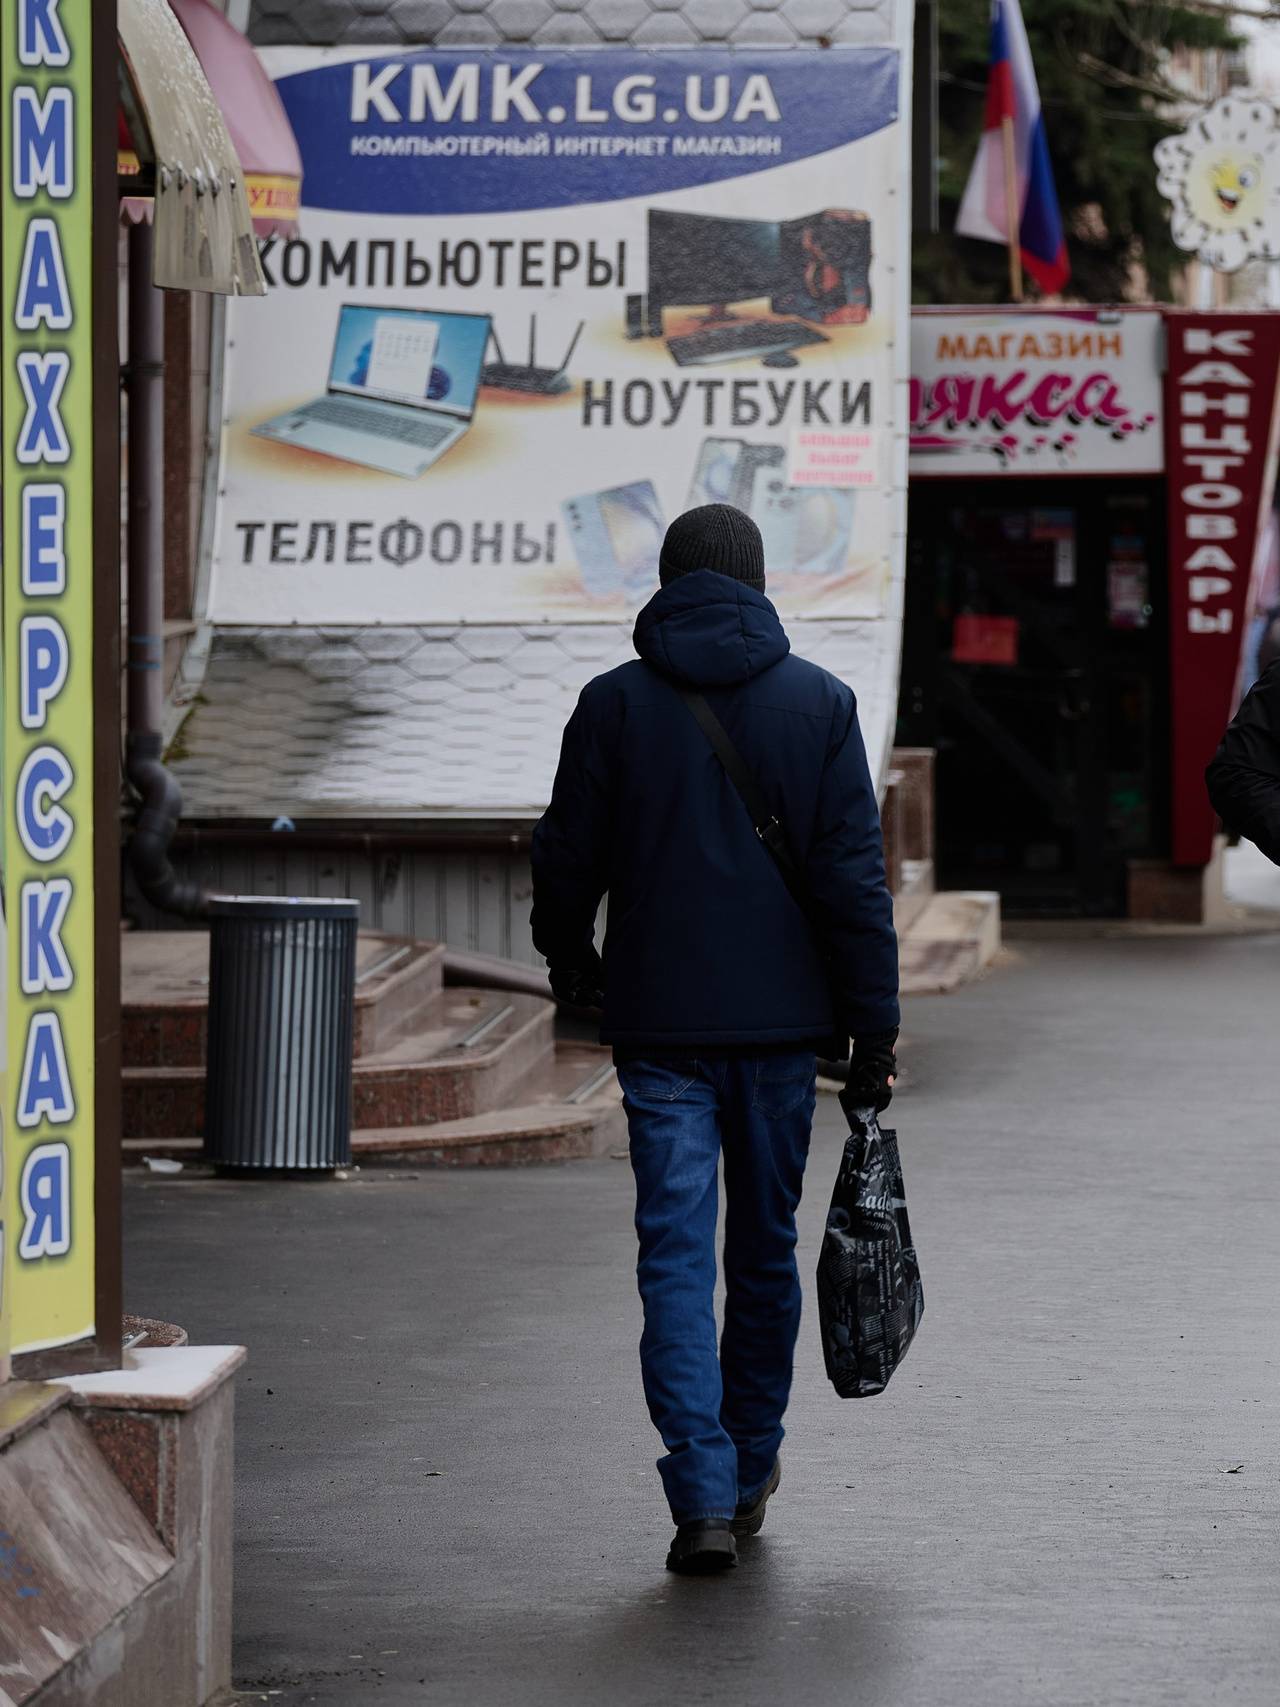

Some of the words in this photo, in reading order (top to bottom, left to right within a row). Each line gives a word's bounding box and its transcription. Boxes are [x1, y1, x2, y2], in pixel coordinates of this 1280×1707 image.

[350, 63, 782, 123] KMK.LG.UA
[351, 133, 549, 157] КОМПЬЮТЕРНЫЙ
[554, 136, 668, 157] ИНТЕРНЕТ
[673, 136, 782, 157] МАГАЗИН
[937, 333, 1123, 359] МАГАЗИН
[582, 378, 871, 427] НОУТБУКИ
[909, 371, 1130, 423] якса
[1178, 329, 1255, 634] КАНЦТОВАРЫ
[235, 517, 557, 566] ТЕЛЕФОНЫ
